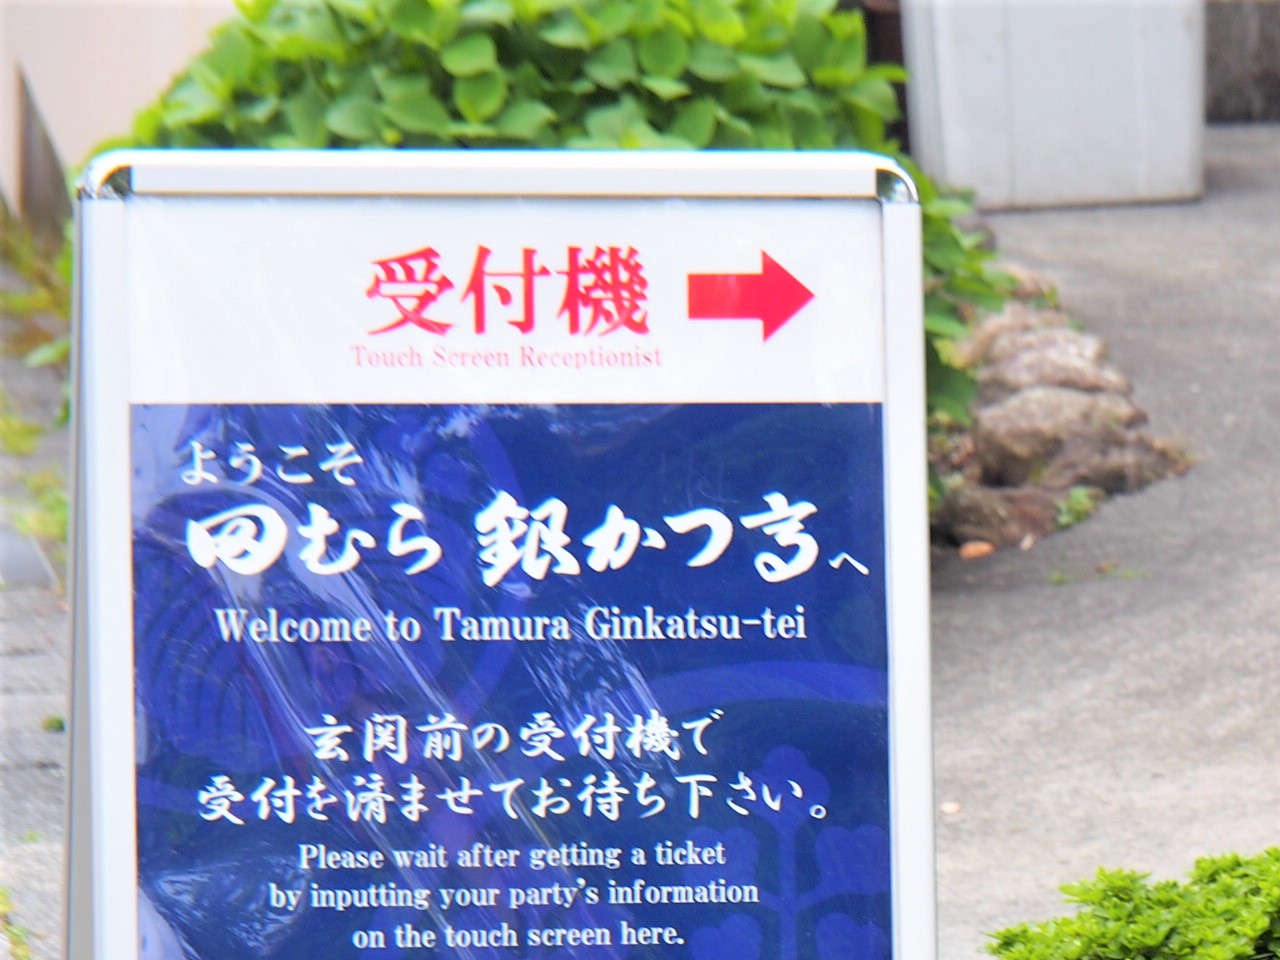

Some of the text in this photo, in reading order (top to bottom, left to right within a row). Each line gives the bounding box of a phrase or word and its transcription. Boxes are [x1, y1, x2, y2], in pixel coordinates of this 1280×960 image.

[364, 244, 651, 337] 受付機
[350, 345, 662, 370] Touch Screen Receptionist
[180, 440, 364, 486] ようこそ
[186, 502, 443, 576] 田むら
[215, 604, 807, 642] Welcome to Tamura Ginkatsu-tei
[306, 708, 724, 762] 玄関前の受付機で
[198, 771, 829, 824] 受付を済ませてお待ち下さい。
[299, 840, 725, 868] Please wait after getting a ticket
[269, 881, 302, 908] by
[310, 880, 429, 908] inputting
[439, 886, 500, 908] your
[607, 878, 759, 902] information
[352, 920, 684, 947] on the touch screen here.
